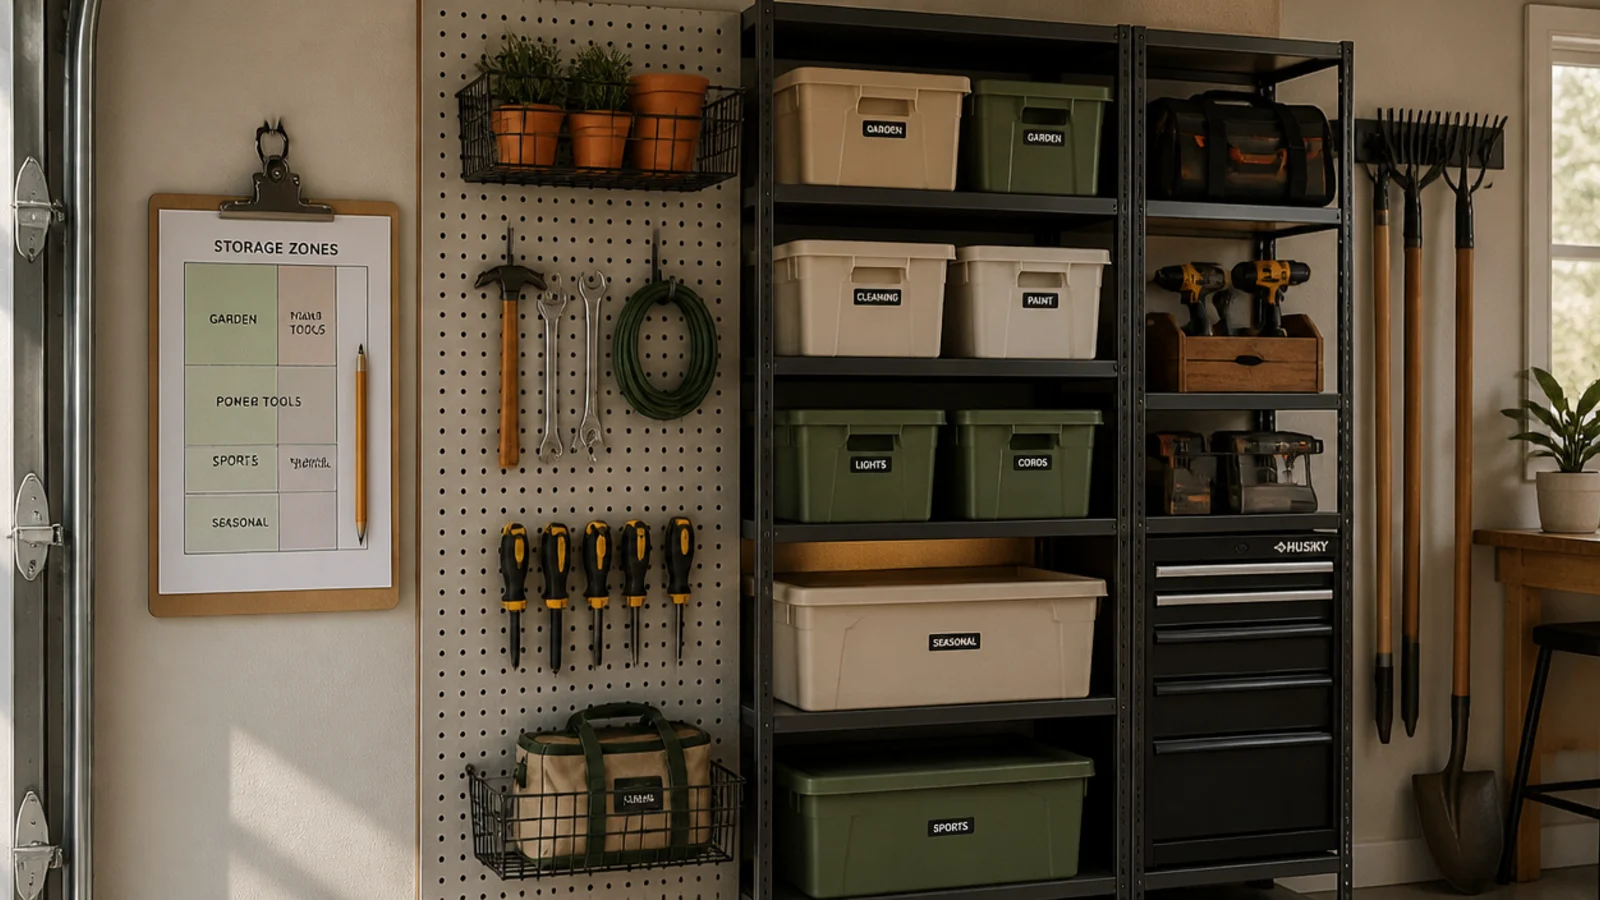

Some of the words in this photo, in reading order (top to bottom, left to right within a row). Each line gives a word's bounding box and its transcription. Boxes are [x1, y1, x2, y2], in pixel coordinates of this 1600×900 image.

[1027, 131, 1063, 144] GARDEN
[213, 239, 284, 255] STORAGE
[288, 242, 339, 256] ZONES
[1027, 295, 1054, 306] PAINT
[209, 313, 258, 325] GARDEN
[261, 395, 302, 408] TOOLS
[212, 454, 259, 468] SPORTS
[212, 517, 269, 528] SEASONAL
[932, 820, 970, 834] SPORTS
